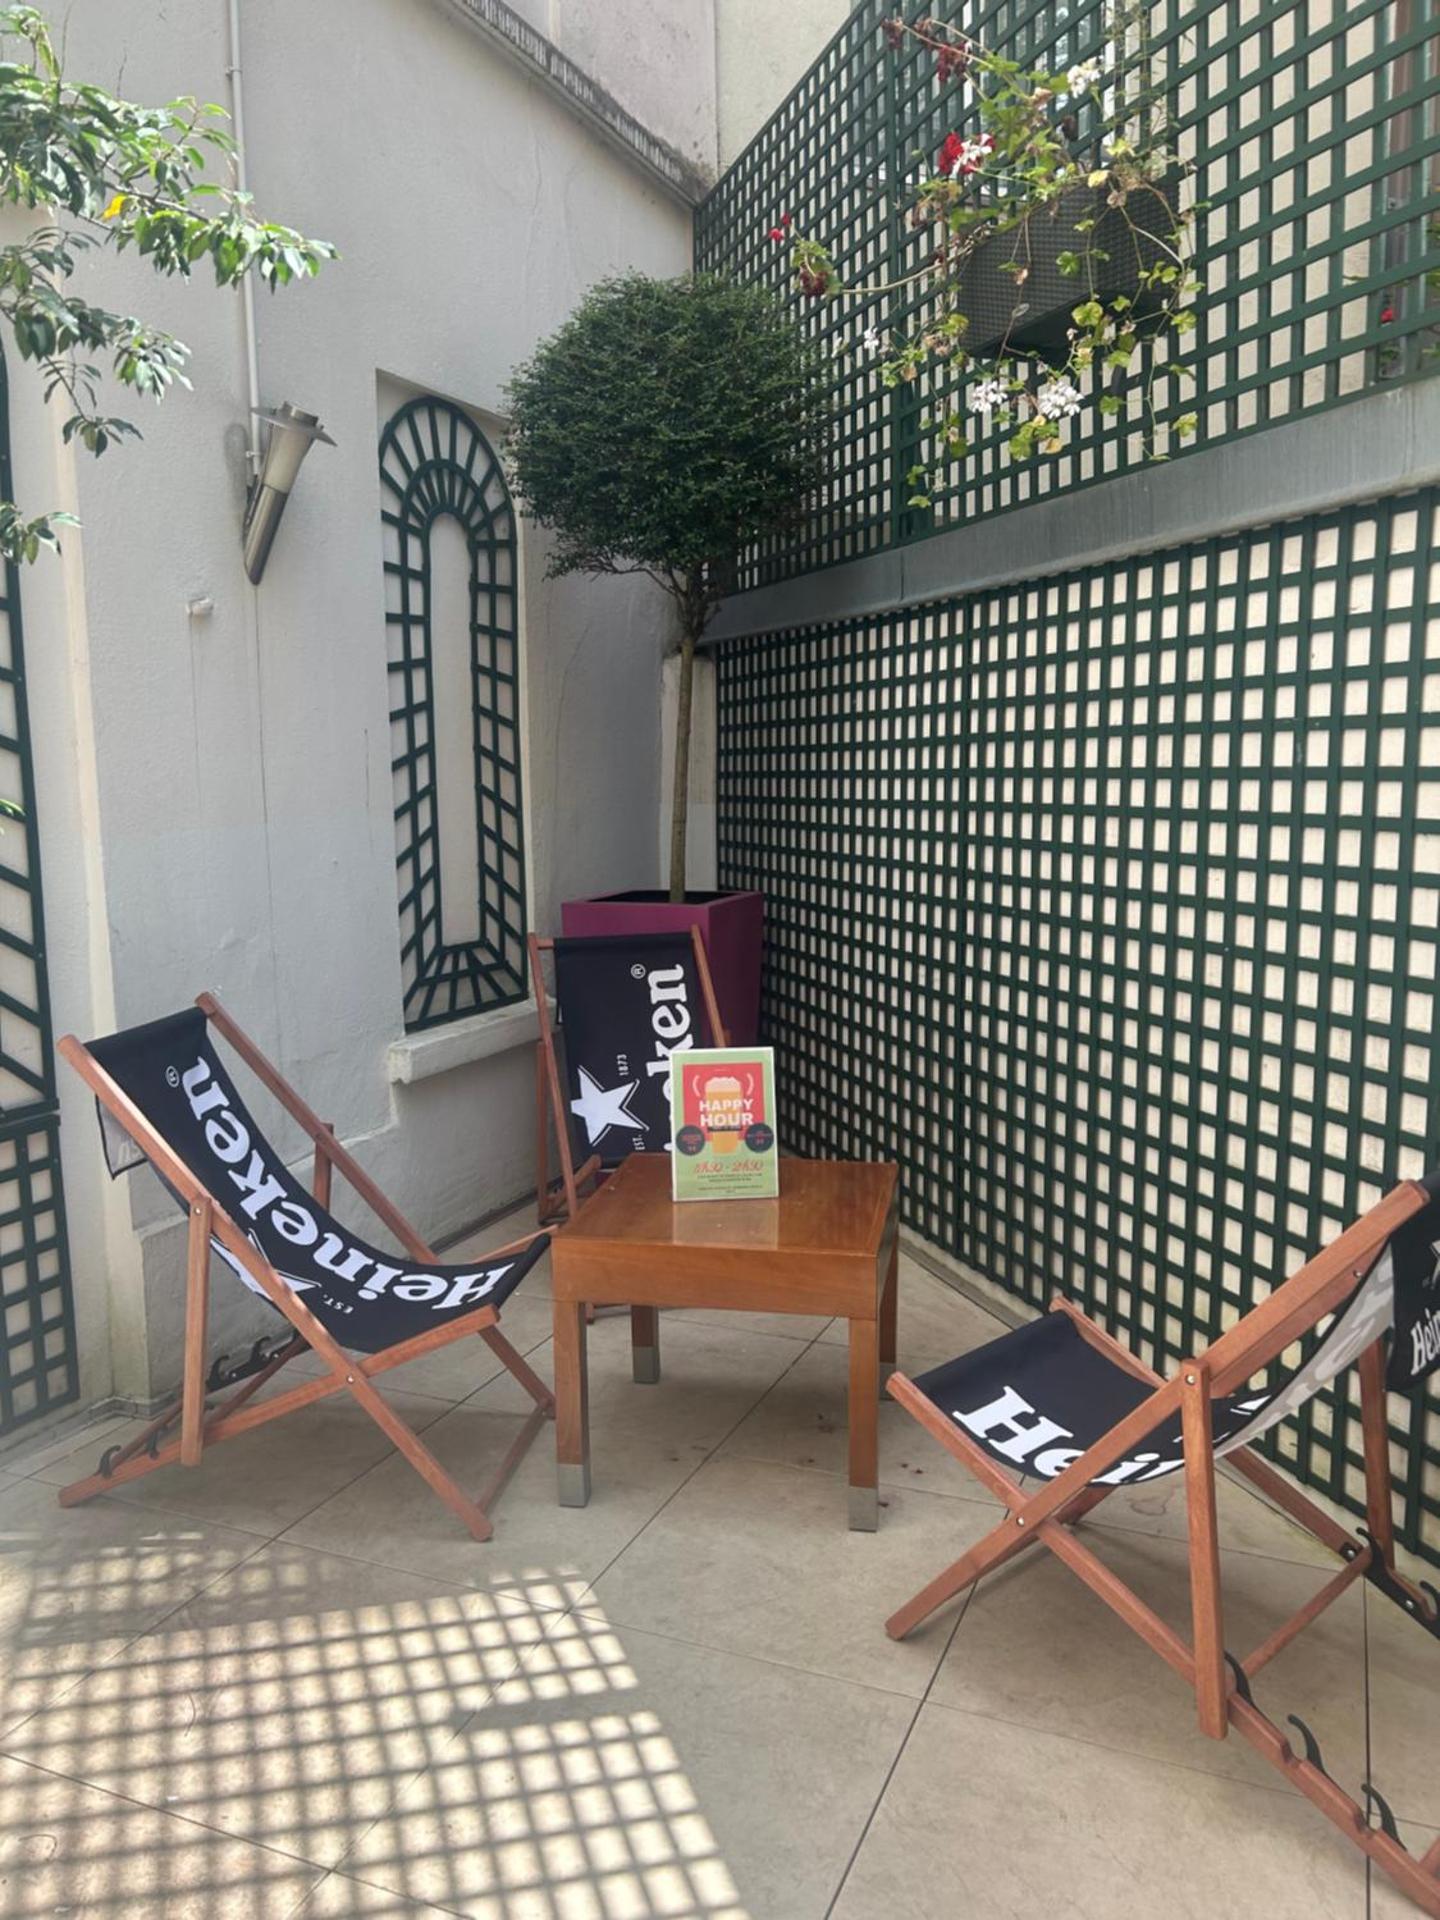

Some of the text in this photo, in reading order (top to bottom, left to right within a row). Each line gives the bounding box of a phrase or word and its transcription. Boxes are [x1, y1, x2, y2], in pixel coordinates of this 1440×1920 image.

[617, 1054, 629, 1076] 1873
[699, 1098, 754, 1113] HAPPY
[700, 1112, 755, 1127] HOUR
[181, 1056, 515, 1310] Heineken
